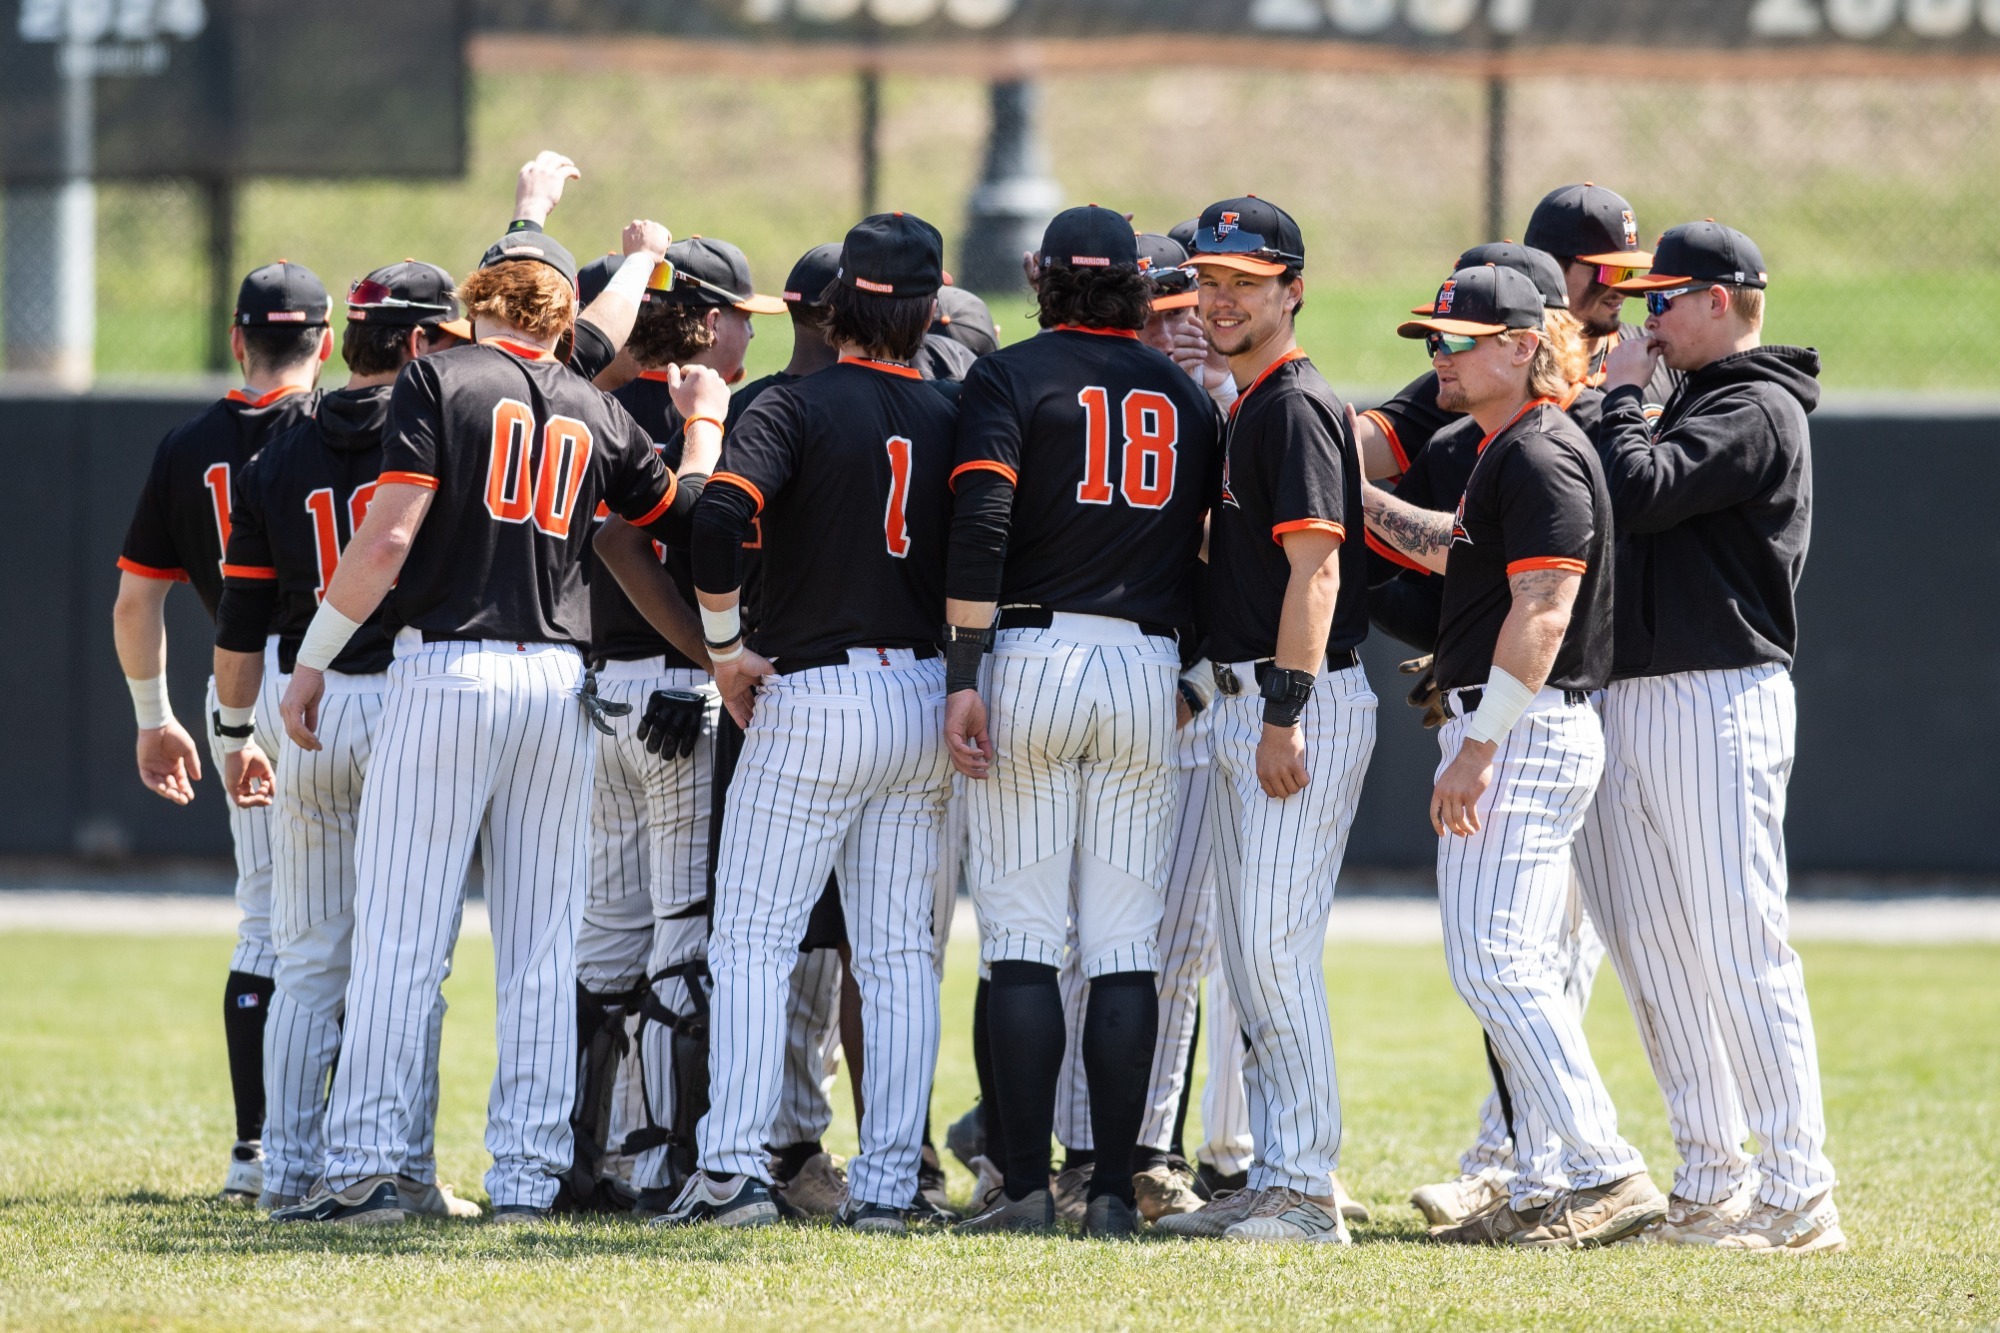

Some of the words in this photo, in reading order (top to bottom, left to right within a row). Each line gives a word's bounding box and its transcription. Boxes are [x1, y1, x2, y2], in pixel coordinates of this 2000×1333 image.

[856, 277, 893, 294] WARRIORS
[1071, 255, 1110, 266] WARRIORS
[484, 397, 593, 540] 00
[885, 435, 912, 558] 1
[1077, 386, 1179, 510] 18
